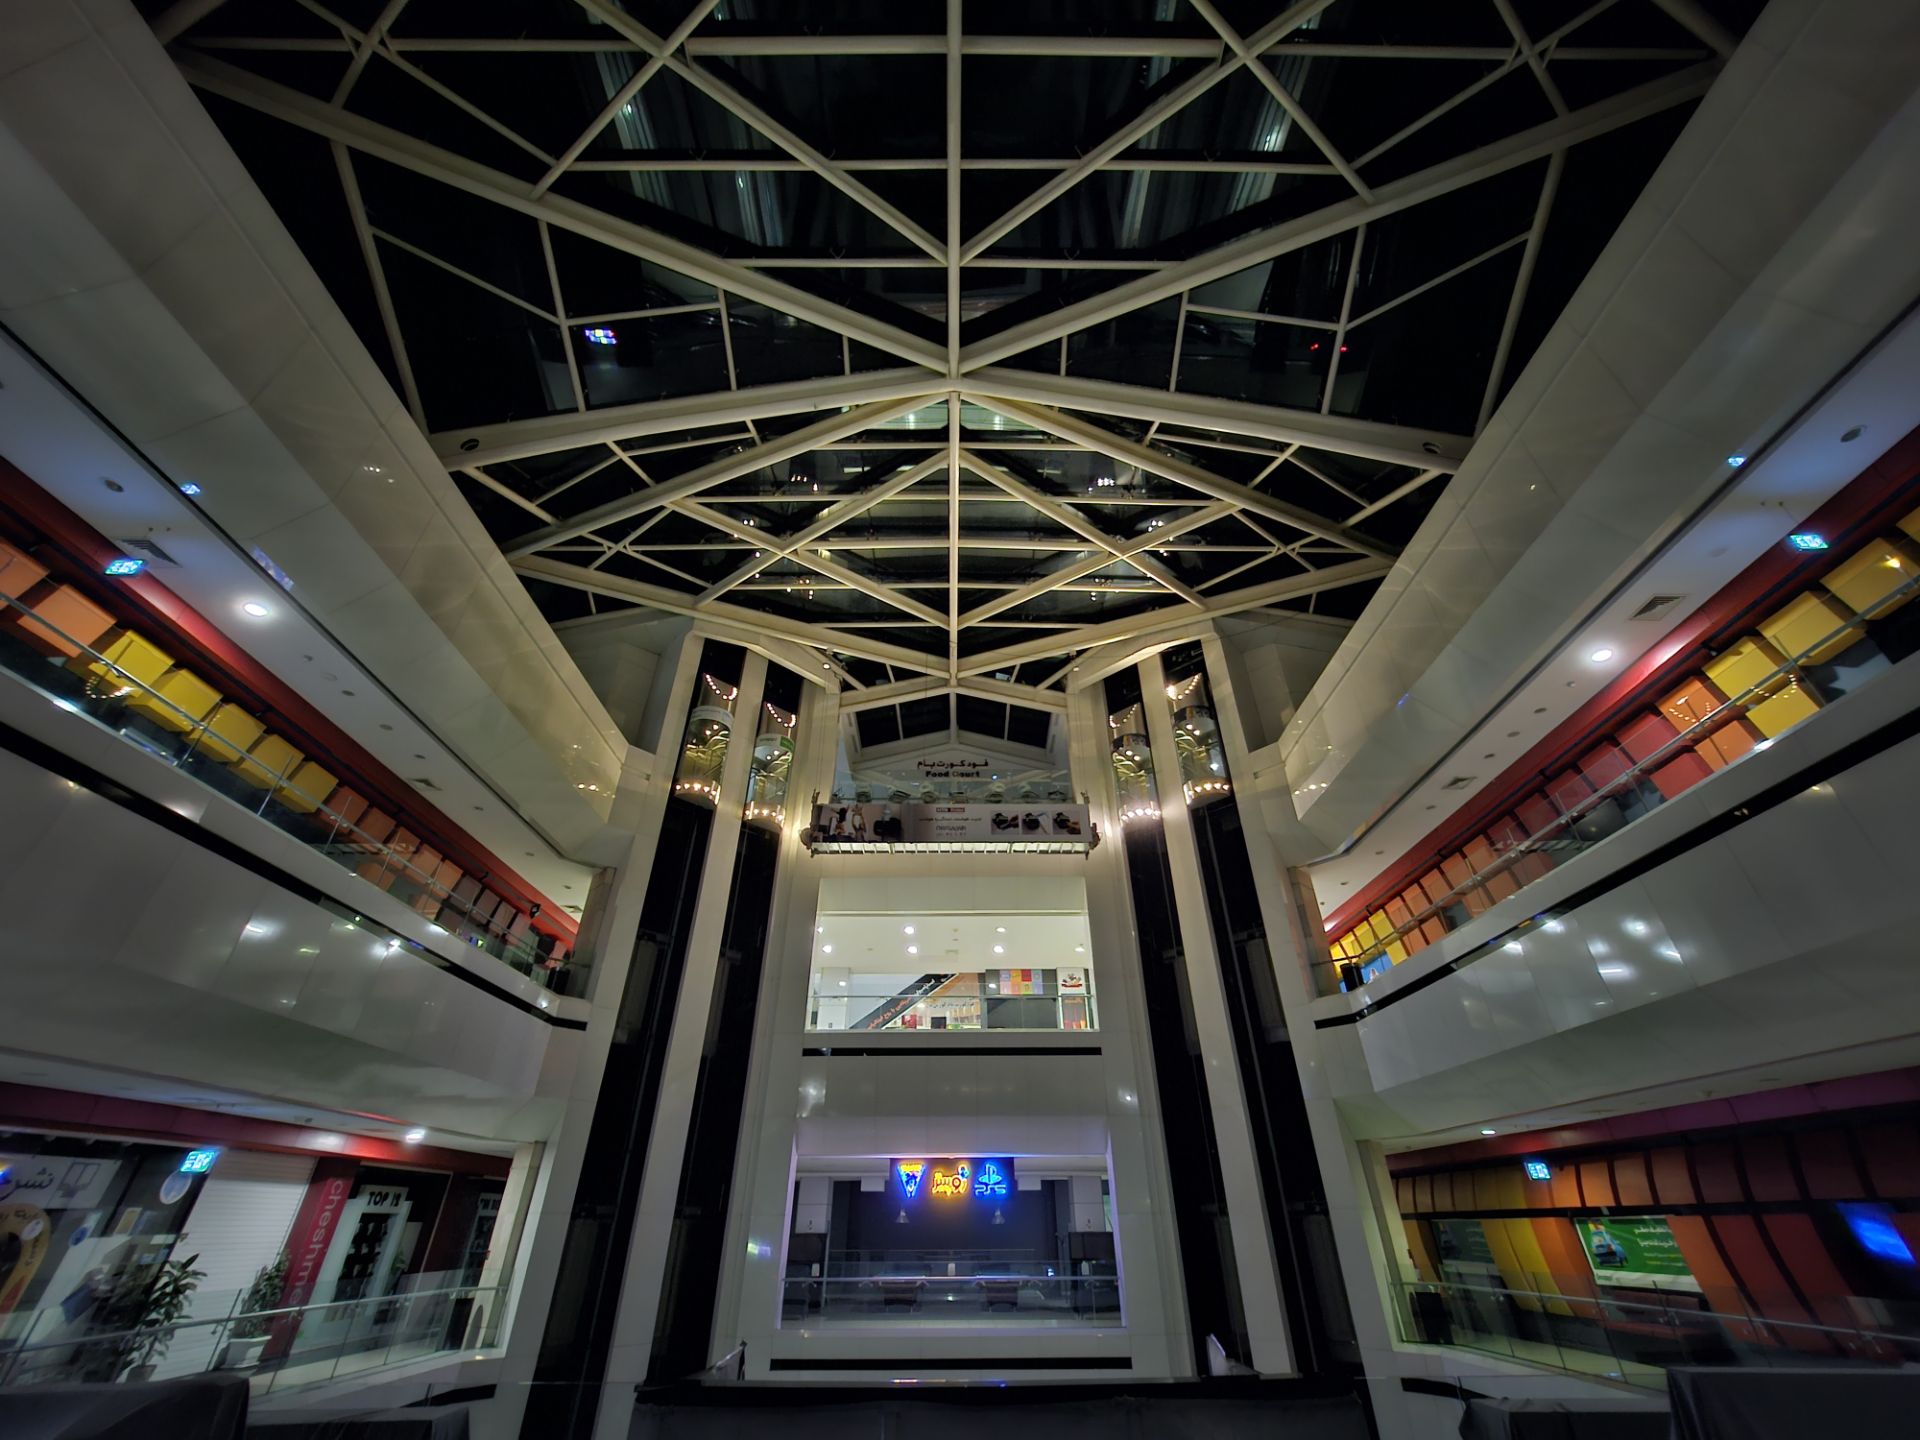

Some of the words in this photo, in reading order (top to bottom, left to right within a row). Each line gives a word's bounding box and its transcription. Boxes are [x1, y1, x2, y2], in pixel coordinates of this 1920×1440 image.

[975, 1184, 1007, 1196] PS5
[367, 1191, 389, 1206] TOP
[289, 1180, 344, 1305] cheshme
